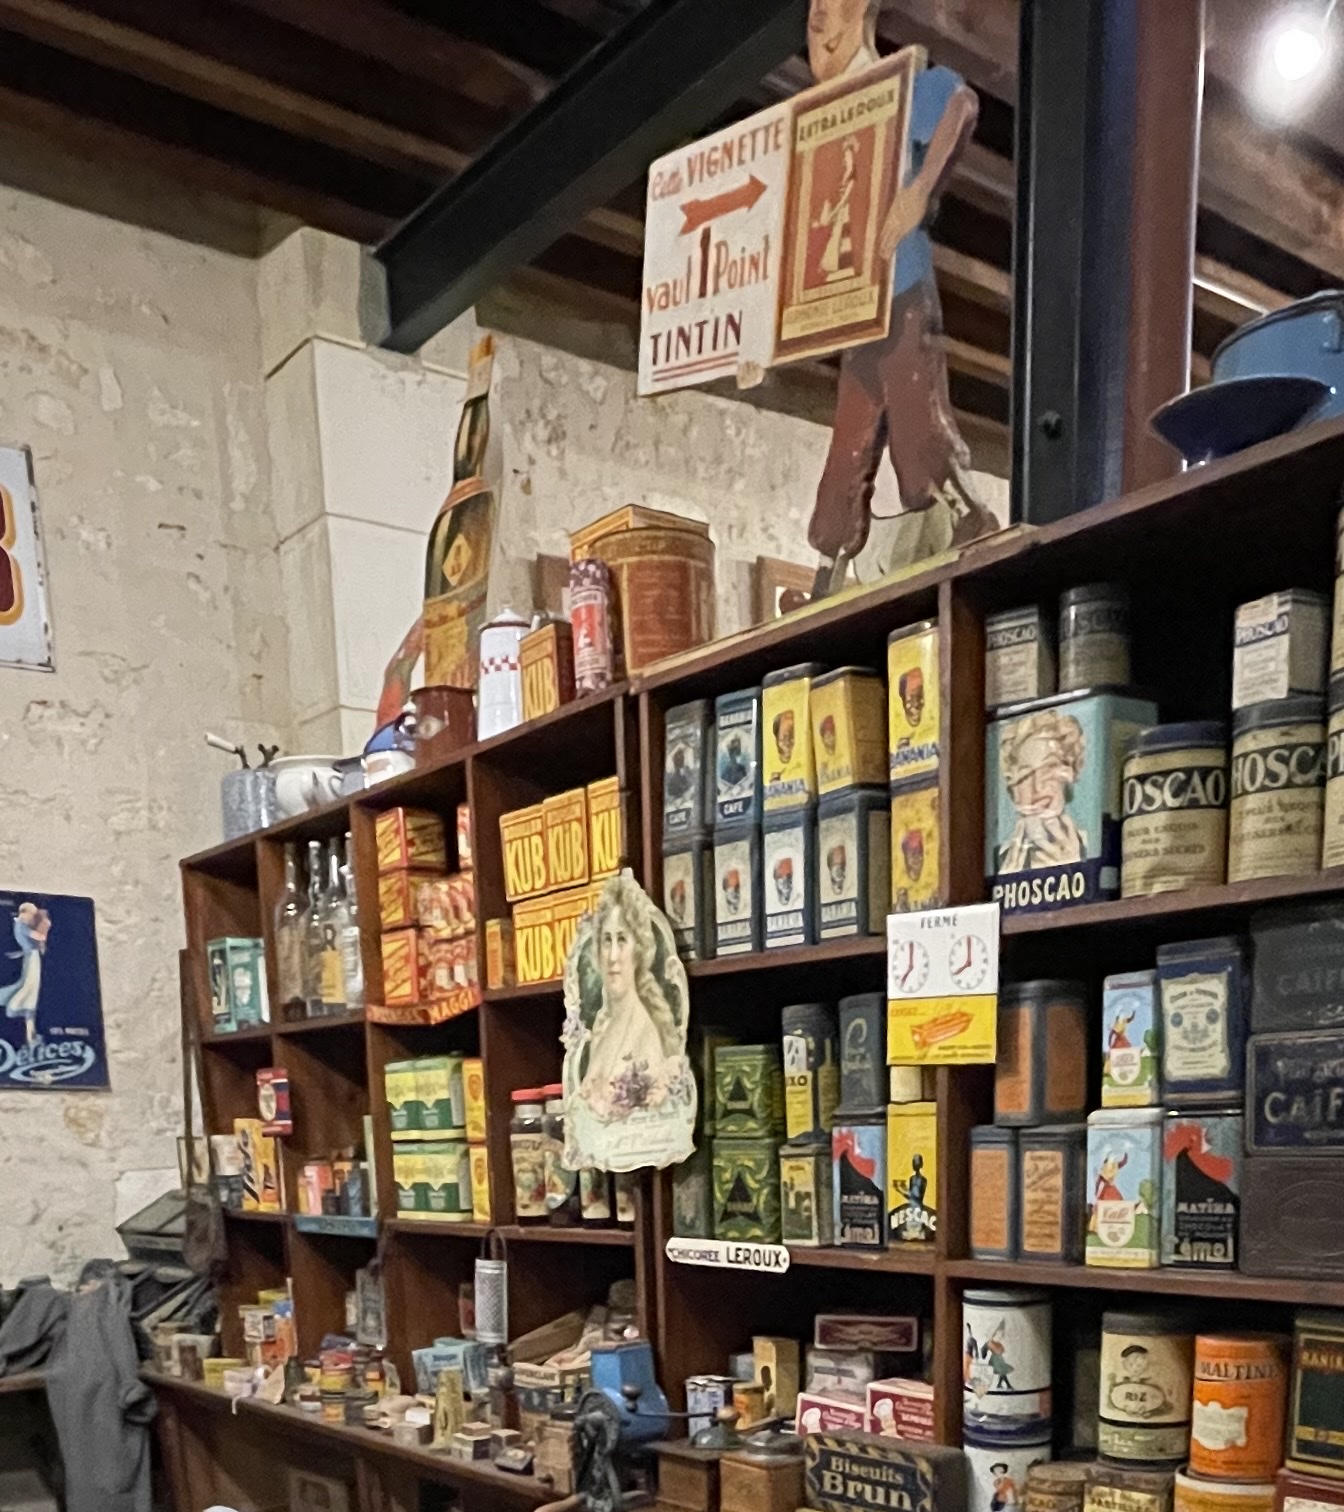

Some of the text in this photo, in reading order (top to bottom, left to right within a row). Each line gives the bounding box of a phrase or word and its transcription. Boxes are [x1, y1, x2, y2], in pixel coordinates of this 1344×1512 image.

[687, 117, 786, 187] VIGNETTE
[646, 225, 771, 315] vaut 1 Point
[649, 309, 743, 365] TINTIN
[506, 834, 547, 896] KUB
[547, 820, 584, 885] KUB
[992, 871, 1086, 911] PHOSCAO
[515, 925, 554, 982] KUB
[726, 1245, 784, 1269] LEROUX
[1124, 1390, 1148, 1403] RIZ
[821, 1470, 913, 1512] Brun
[830, 1455, 905, 1485] Biscuits
